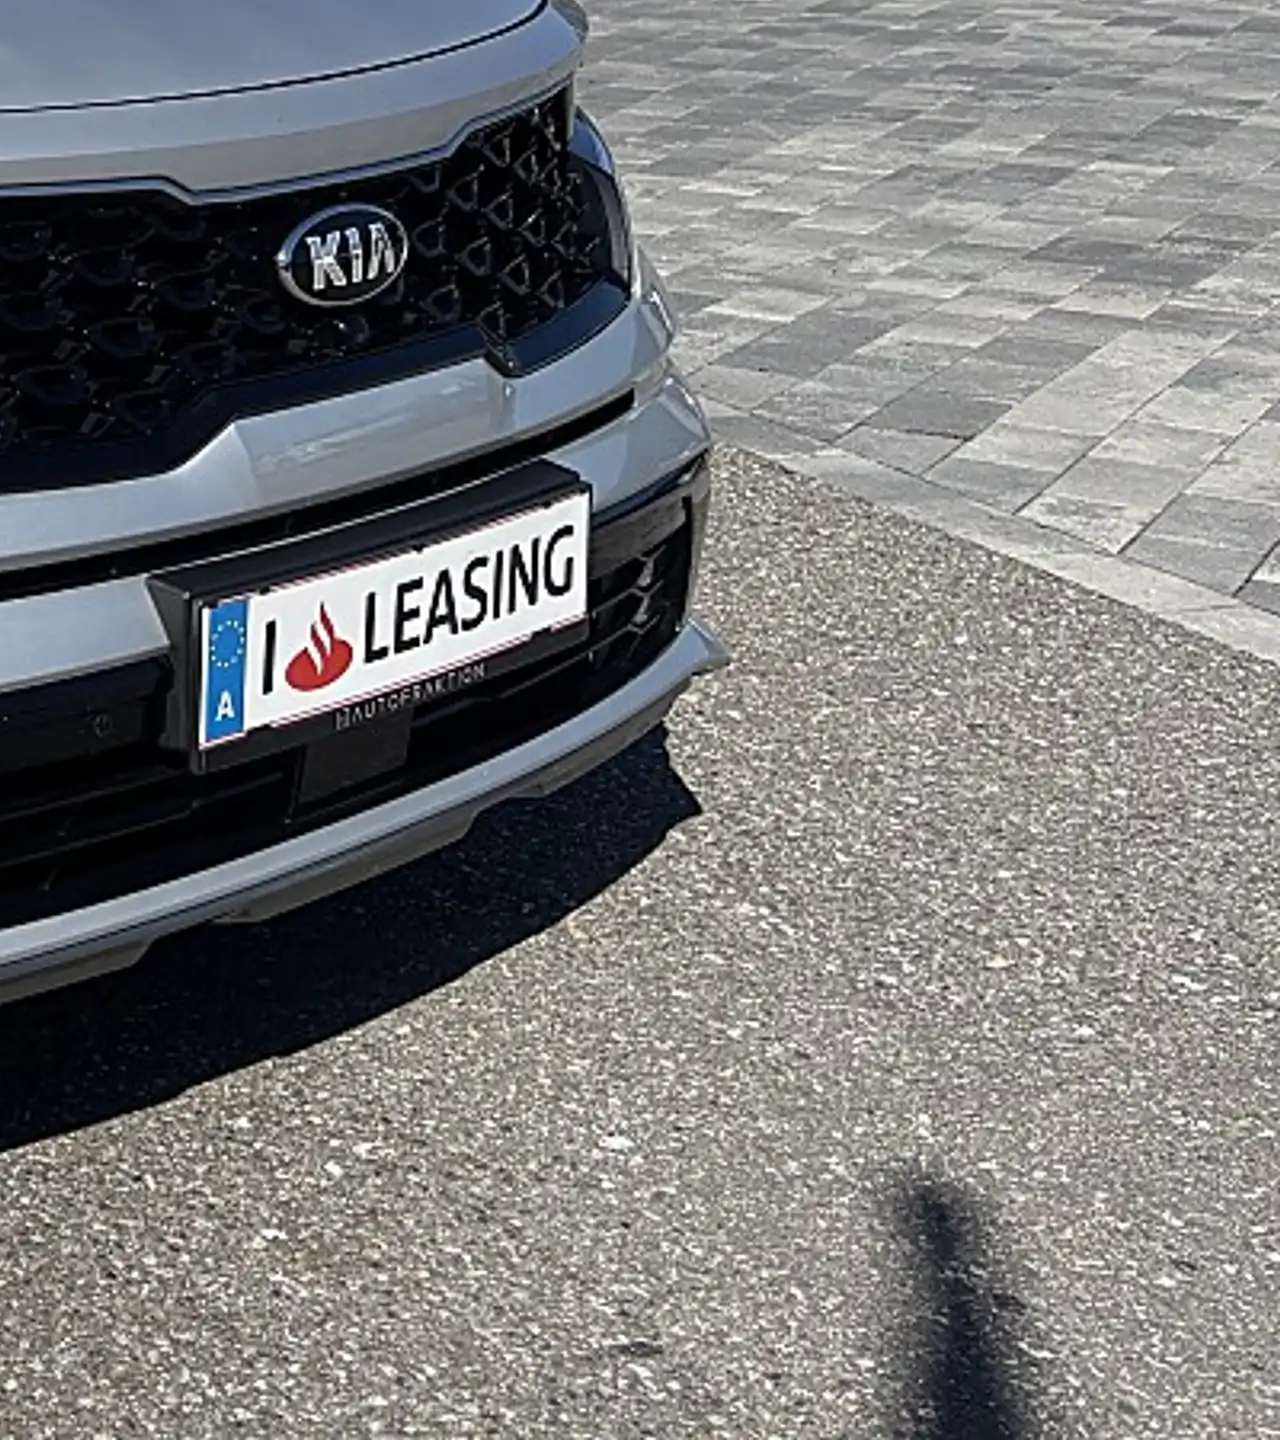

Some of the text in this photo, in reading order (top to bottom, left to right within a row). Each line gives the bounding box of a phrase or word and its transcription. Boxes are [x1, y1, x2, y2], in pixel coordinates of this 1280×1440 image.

[304, 221, 396, 290] KIA
[261, 524, 575, 696] I LEASING
[214, 690, 236, 722] A
